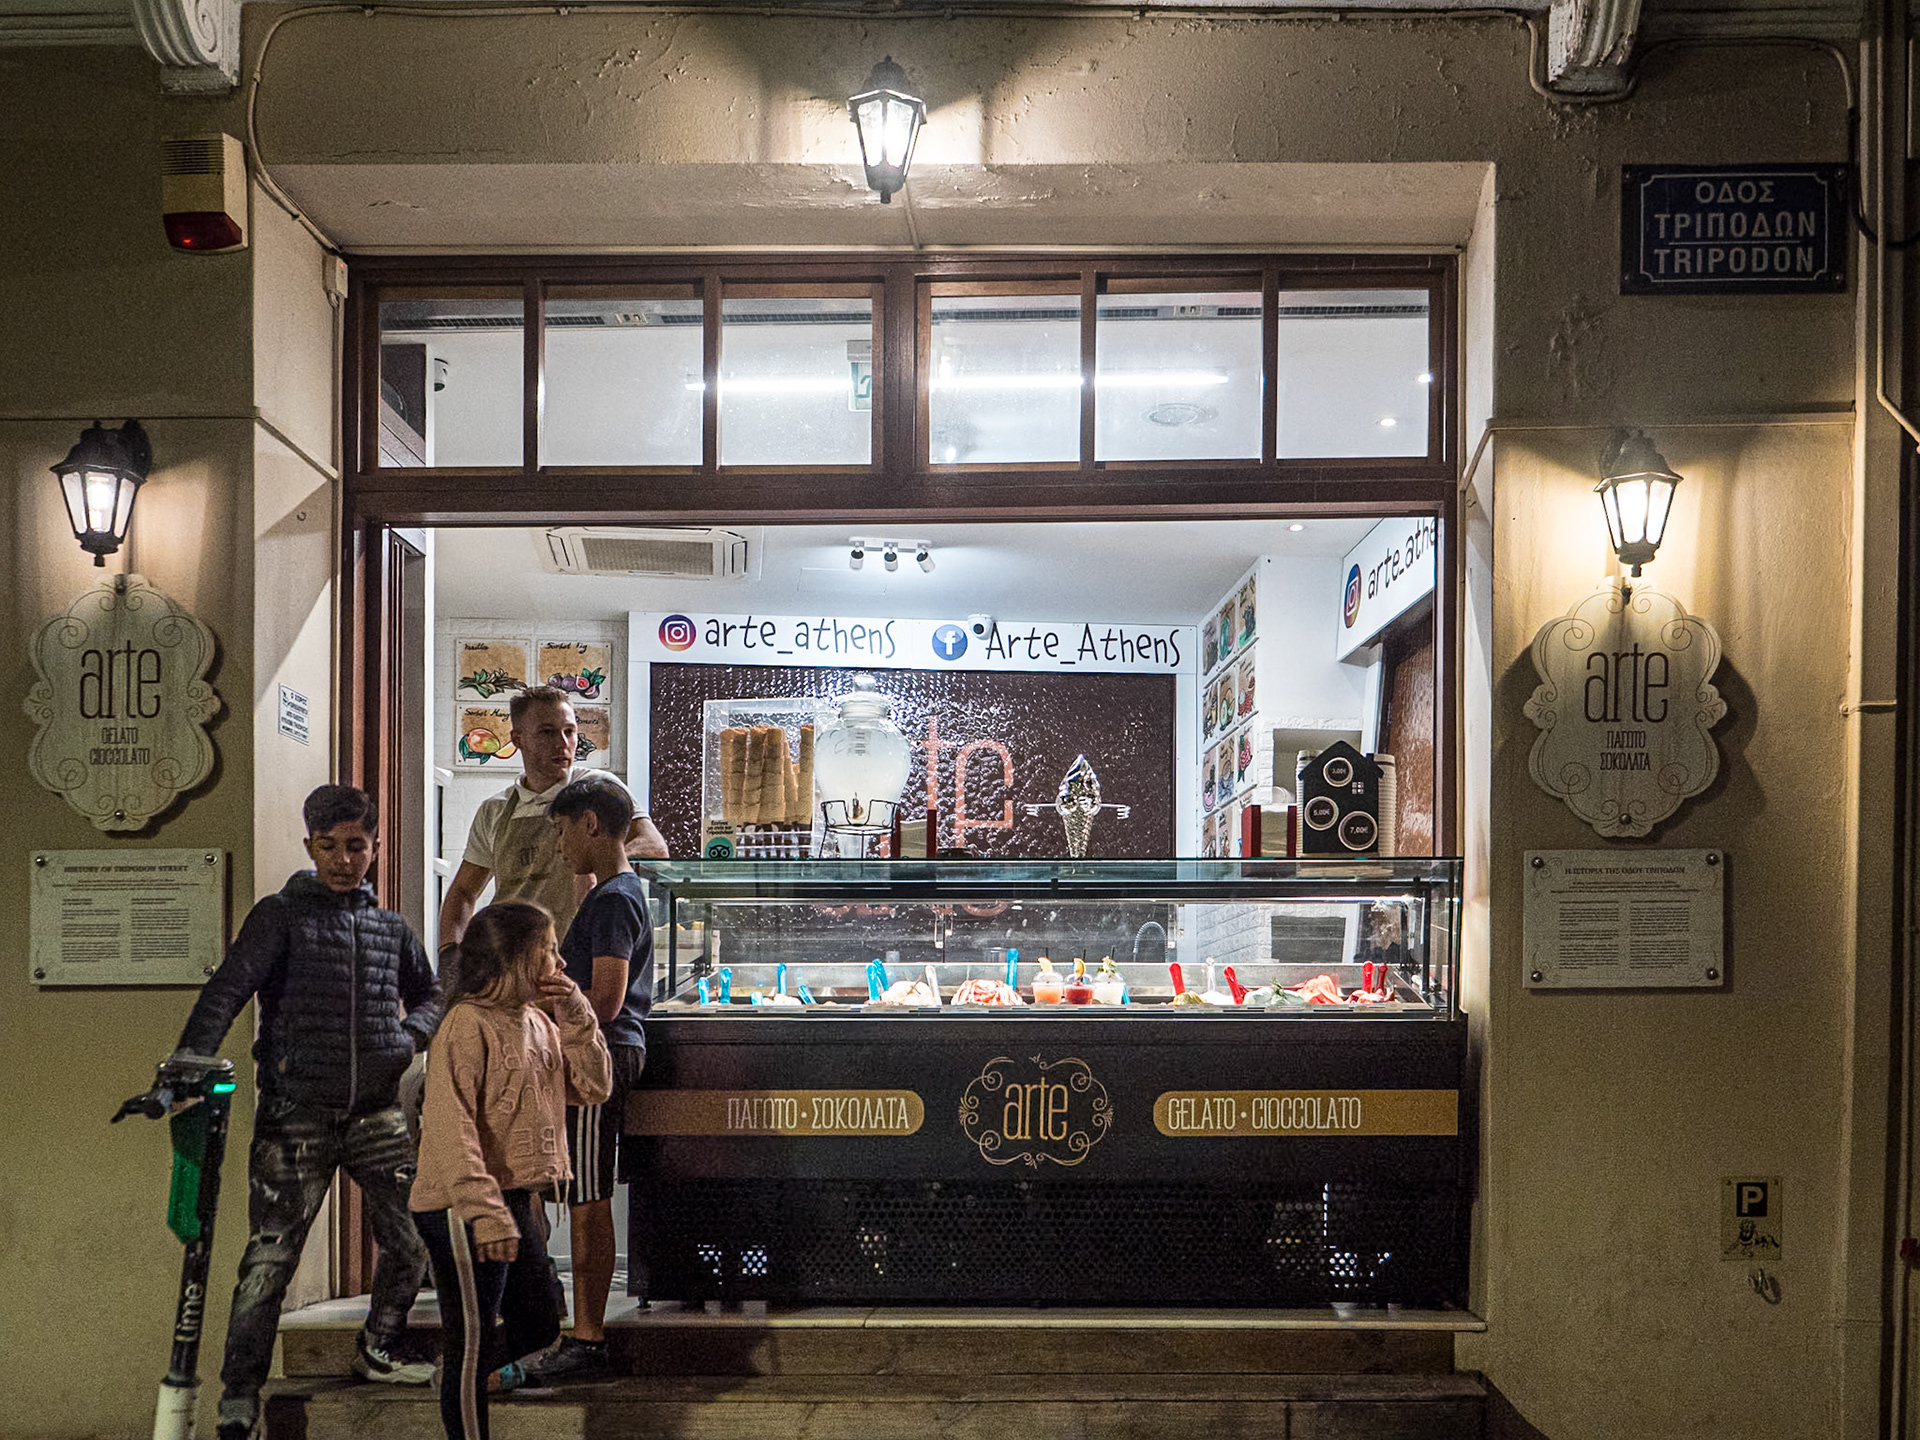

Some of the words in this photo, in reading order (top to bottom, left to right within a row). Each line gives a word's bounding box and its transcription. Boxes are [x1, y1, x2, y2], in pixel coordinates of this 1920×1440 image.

[1695, 181, 1775, 203] ΟΔΟΣ
[1654, 211, 1816, 239] ΤΡΙΠΟΔΩΝ
[1654, 246, 1814, 274] TRIPODON
[1367, 517, 1436, 600] arte_athe
[79, 639, 162, 720] arte
[1584, 642, 1669, 724] arte
[490, 708, 511, 723] Mang
[101, 726, 139, 745] GELATO
[1606, 730, 1646, 749] ΠΑΓΩΤΟ
[89, 747, 150, 766] CIOCCOLATO
[1599, 751, 1651, 771] ΣΟΚΟΛΑΤΑ
[726, 1097, 798, 1130] ΠΑΓΩΤΟ
[811, 1097, 910, 1130] ΣΟΚΟΛΑΤΑ
[1002, 1076, 1068, 1140] arte
[1167, 1096, 1236, 1131] GELATO
[1251, 1096, 1362, 1130] CIOCCOLATO
[1741, 1185, 1764, 1213] P
[174, 1282, 204, 1342] Lime
